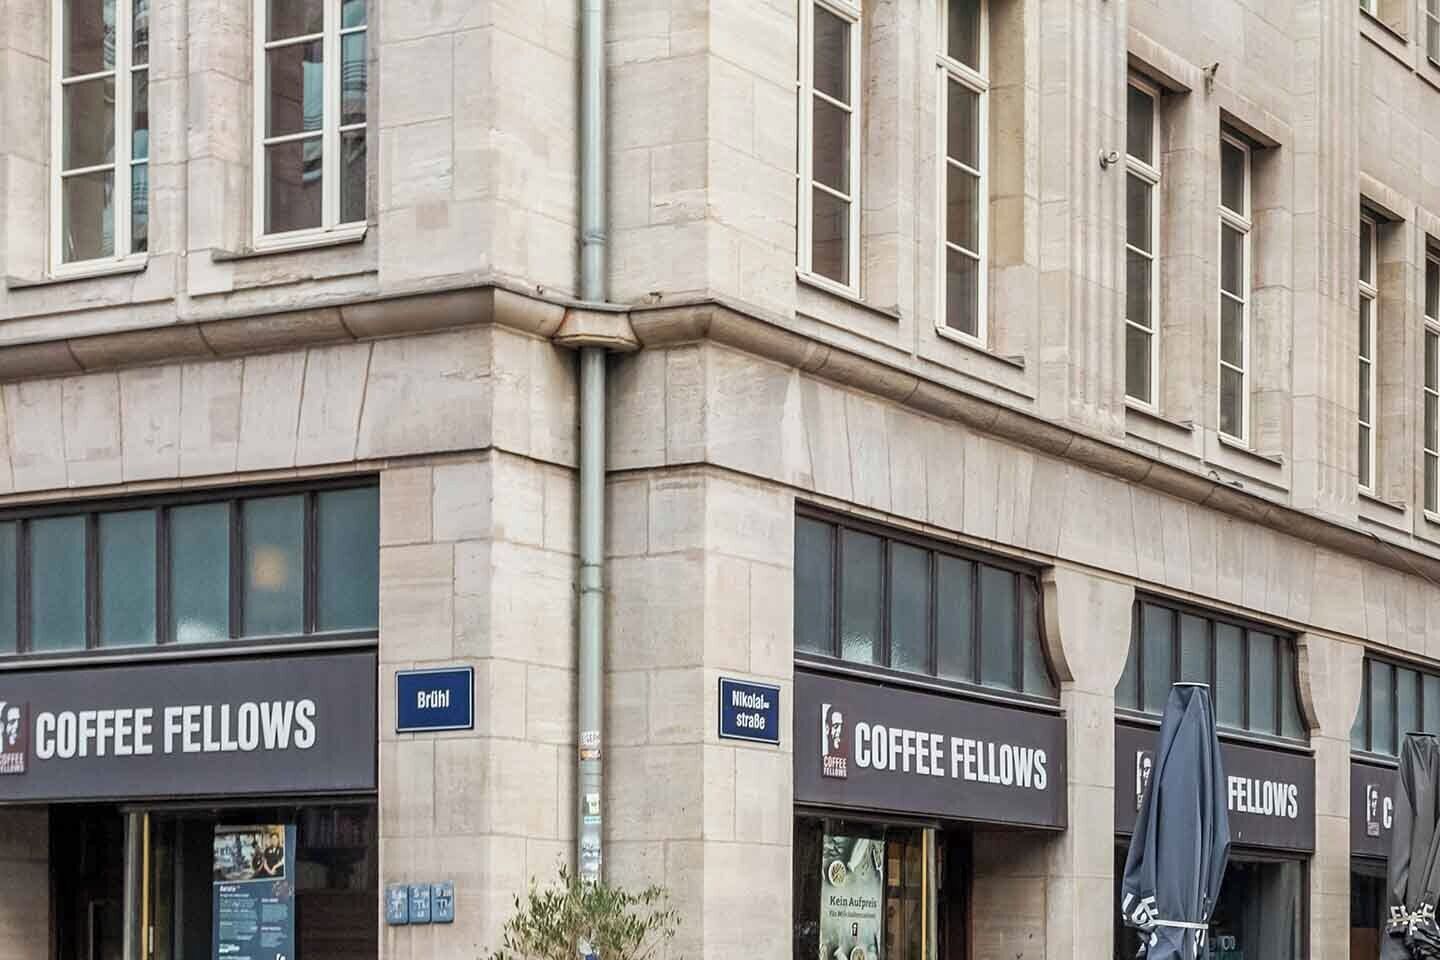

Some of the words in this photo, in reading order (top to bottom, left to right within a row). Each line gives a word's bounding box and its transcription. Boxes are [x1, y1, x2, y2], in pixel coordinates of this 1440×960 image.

[417, 689, 450, 709] Brühl
[36, 707, 153, 760] COFFEE
[163, 699, 316, 754] FELLOWS
[736, 711, 766, 731] straße
[855, 722, 945, 777] COFFEE
[951, 736, 1048, 790] FELLOWS
[1227, 775, 1298, 819] FELLOWS
[830, 896, 847, 906] Kein
[849, 896, 877, 910] Aufpreis
